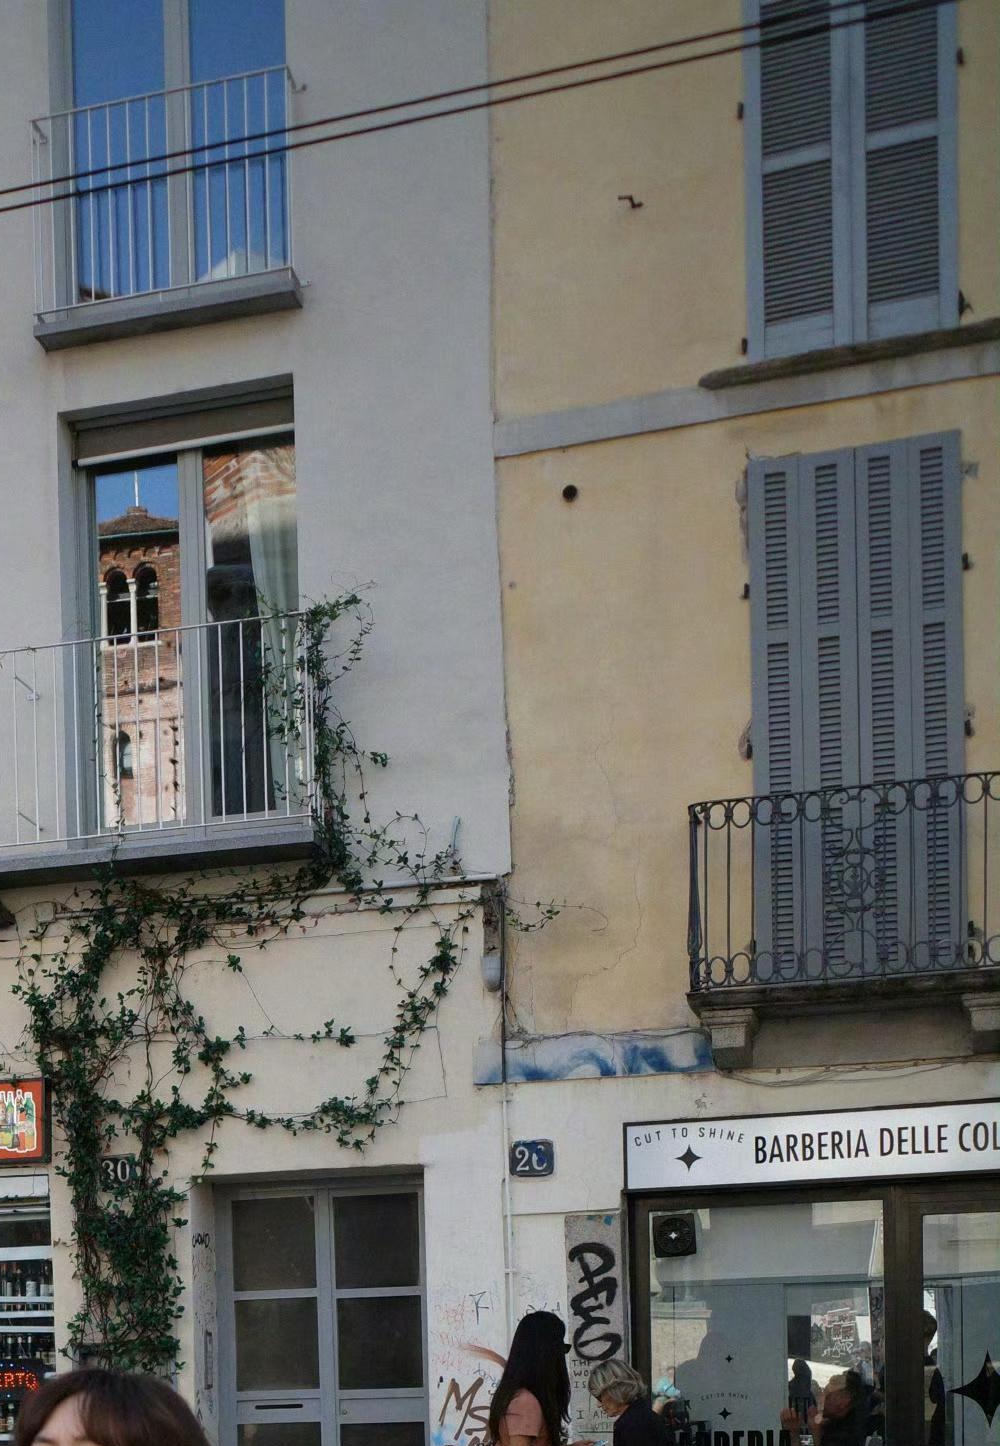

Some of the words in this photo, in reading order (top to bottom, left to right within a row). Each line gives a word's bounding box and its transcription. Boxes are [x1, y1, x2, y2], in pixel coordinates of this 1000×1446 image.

[634, 1130, 661, 1147] CUT
[671, 1127, 688, 1139] TO
[698, 1127, 745, 1144] SHINE
[754, 1129, 870, 1164] BARBERIA
[879, 1123, 948, 1157] DELLE
[958, 1121, 1000, 1152] COL
[101, 1159, 130, 1182] 30
